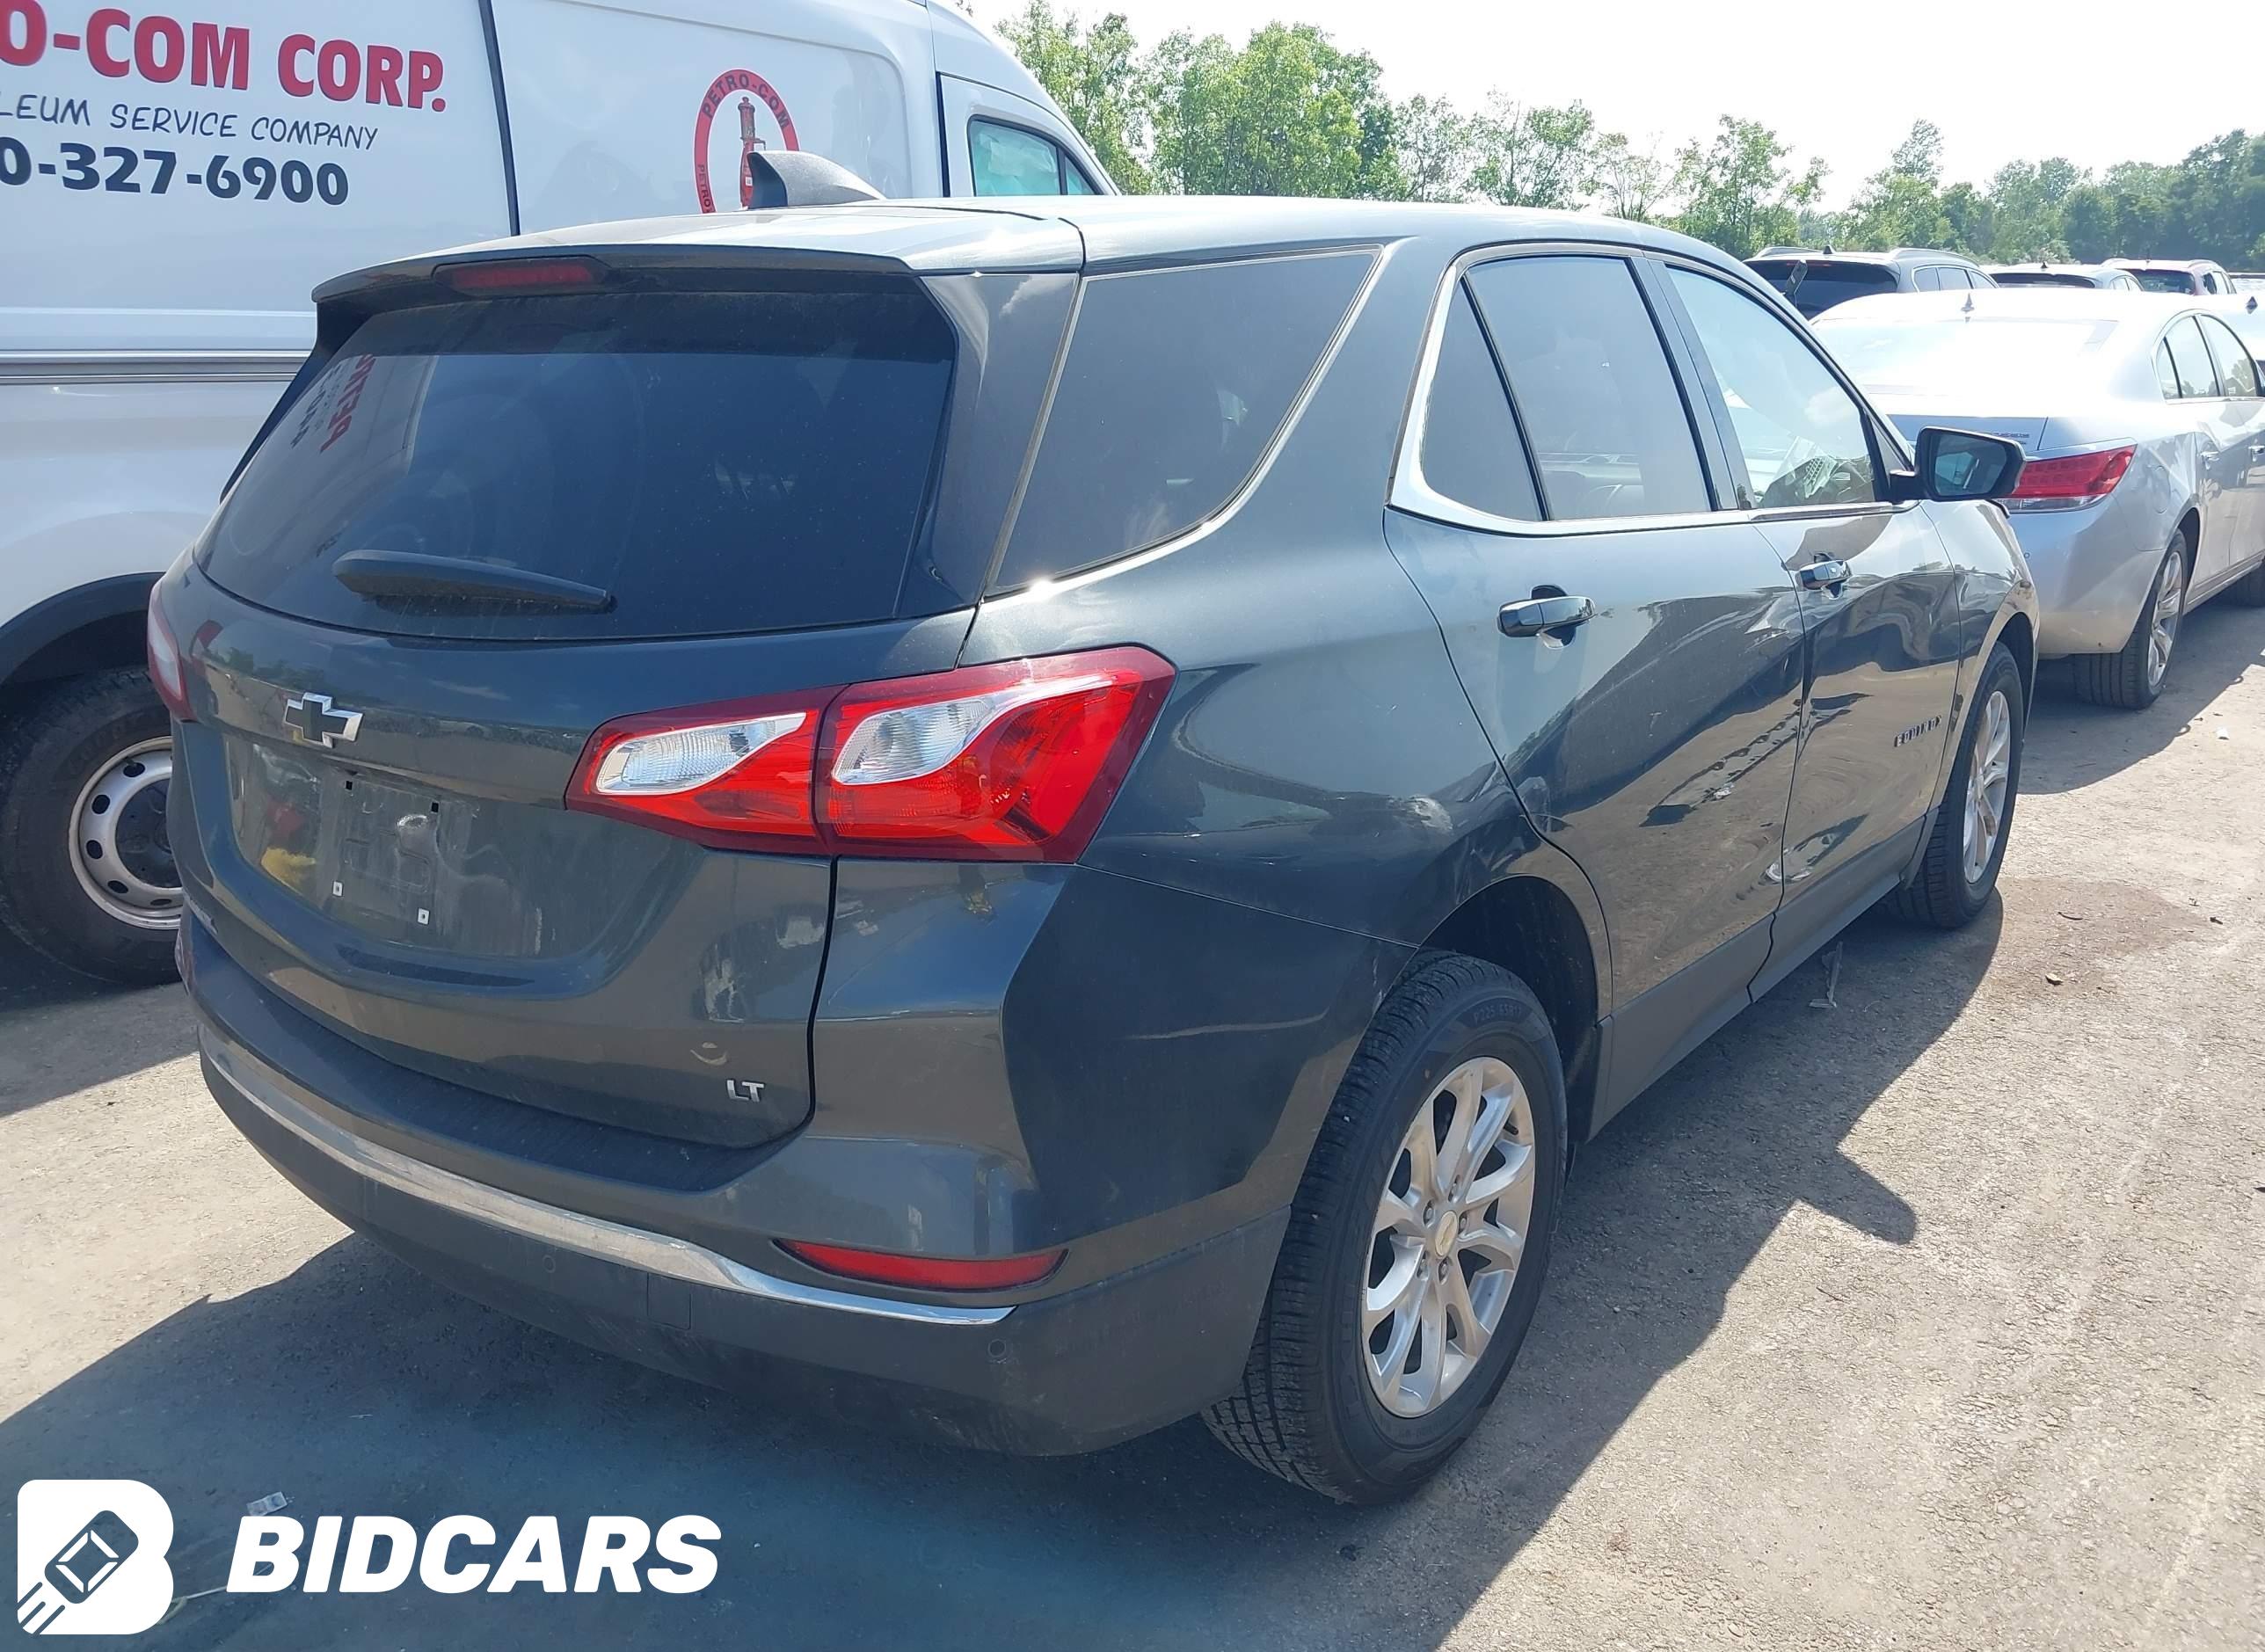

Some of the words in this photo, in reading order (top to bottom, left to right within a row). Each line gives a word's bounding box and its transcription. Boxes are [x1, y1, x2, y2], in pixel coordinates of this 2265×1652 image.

[277, 33, 447, 113] CORP.
[702, 73, 790, 131] PETRO-COM
[110, 103, 238, 138] SERVICE
[251, 116, 379, 150] COMPANY
[0, 136, 350, 206] 0-327-6900
[726, 1079, 765, 1103] LT
